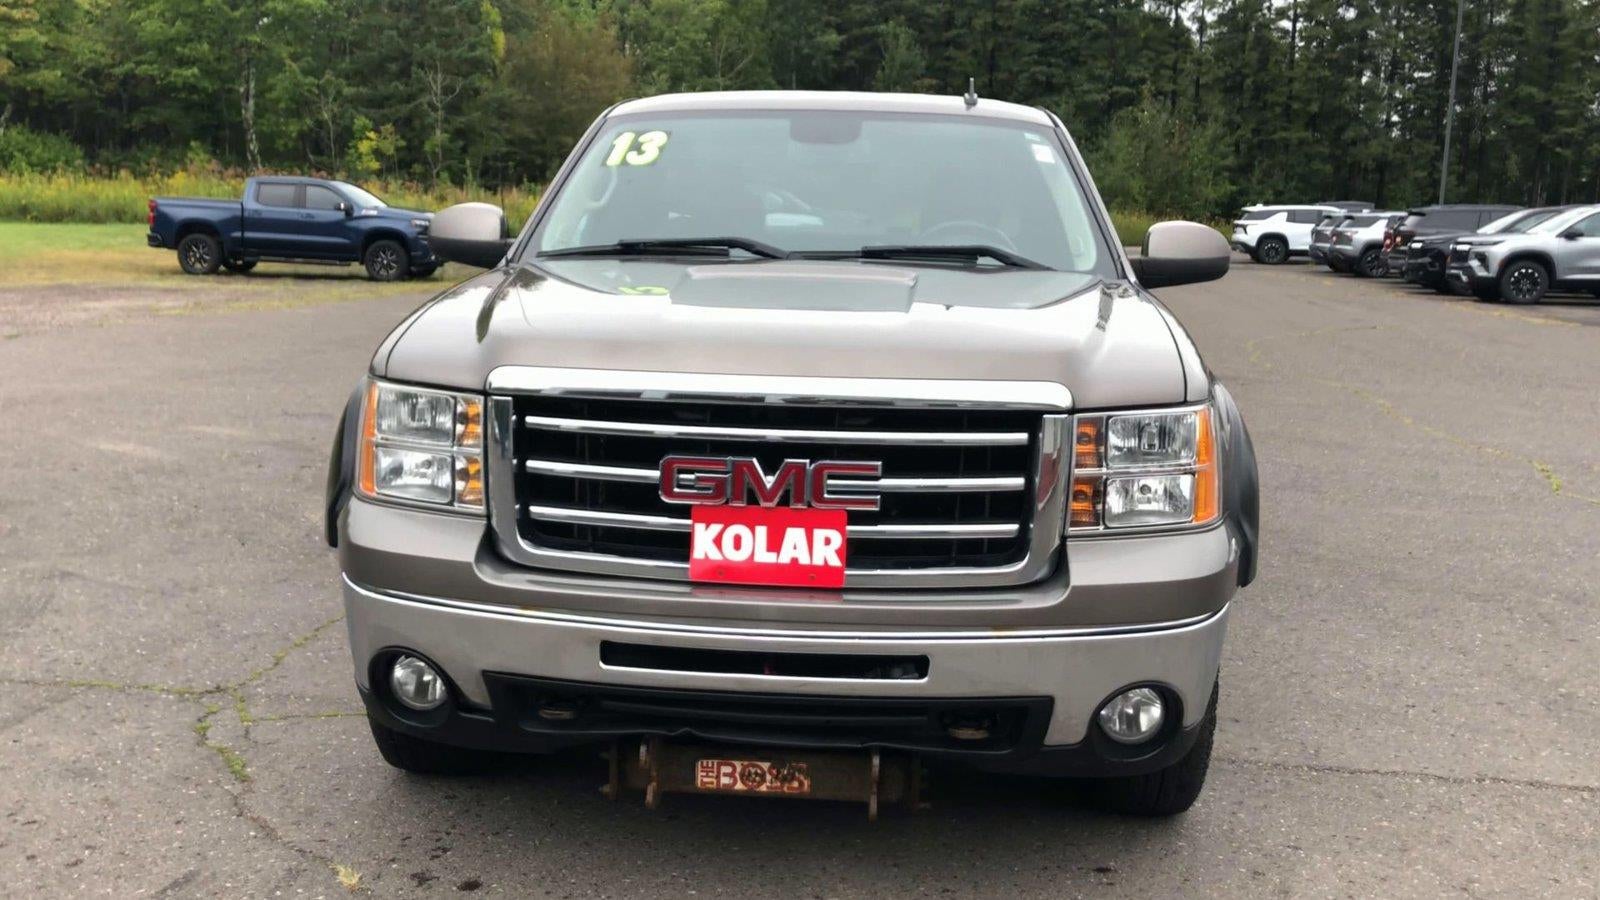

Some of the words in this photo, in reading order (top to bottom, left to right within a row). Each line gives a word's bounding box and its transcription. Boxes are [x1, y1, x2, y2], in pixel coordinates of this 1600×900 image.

[606, 130, 668, 166] 13
[659, 455, 882, 511] GMC
[692, 523, 843, 567] KOLAR
[700, 760, 715, 789] THE
